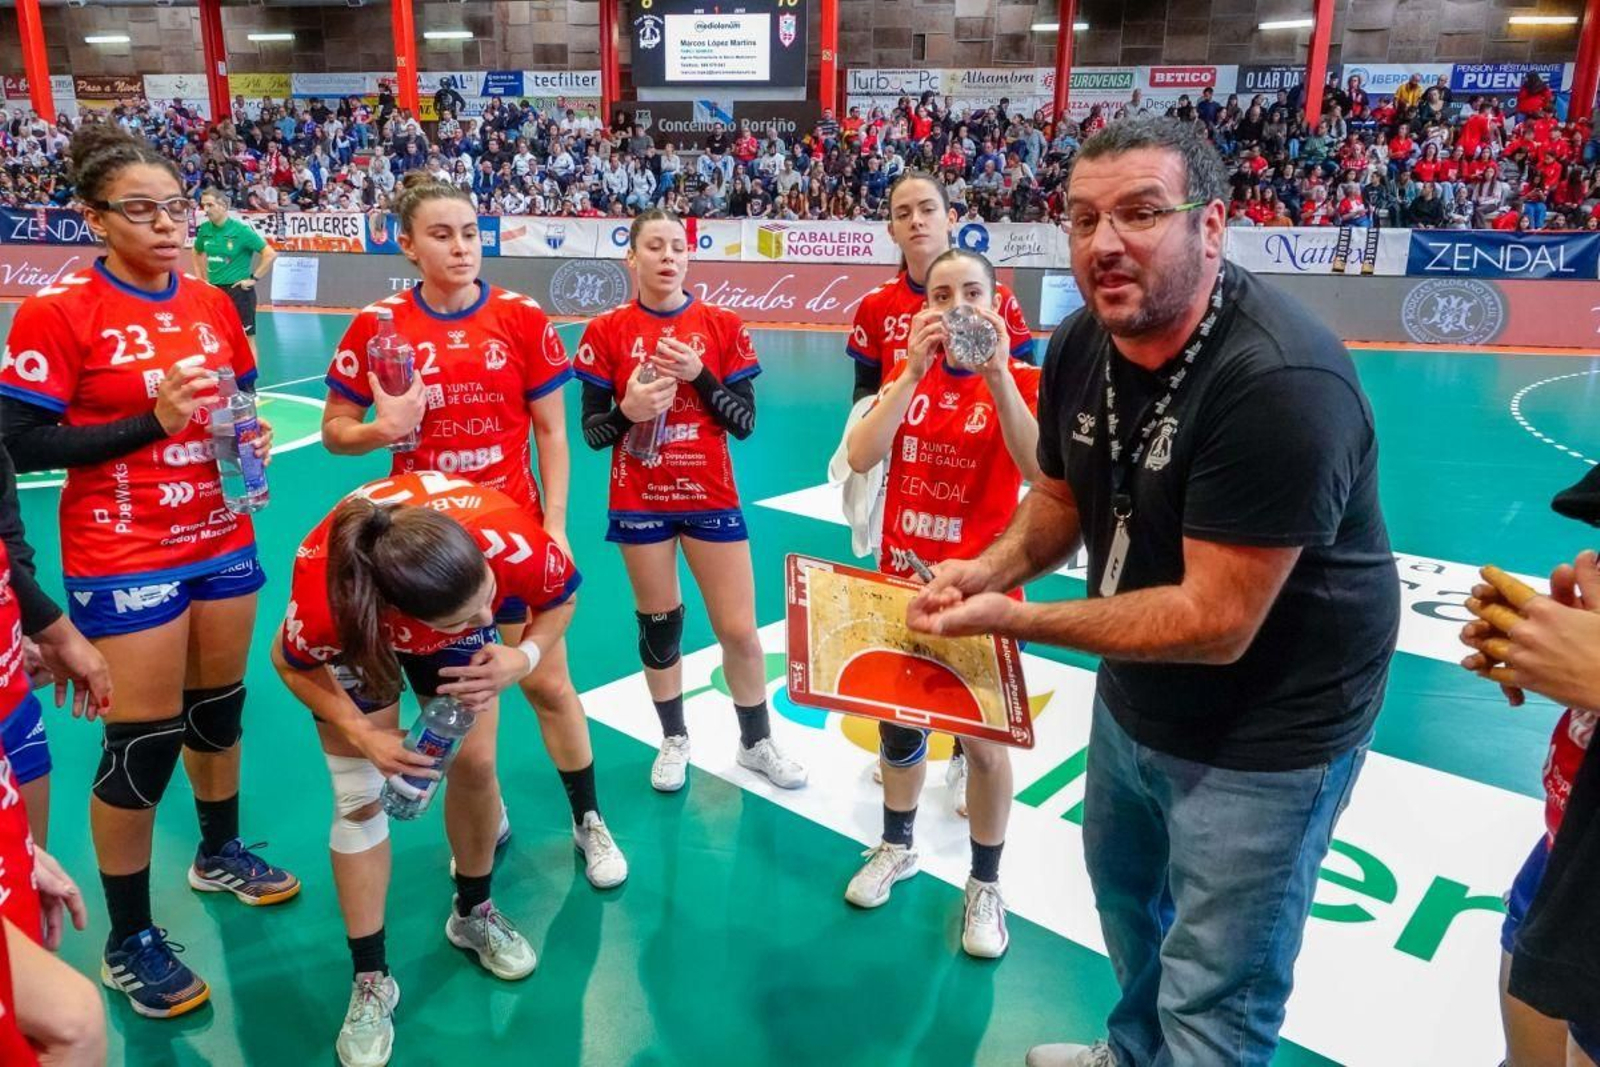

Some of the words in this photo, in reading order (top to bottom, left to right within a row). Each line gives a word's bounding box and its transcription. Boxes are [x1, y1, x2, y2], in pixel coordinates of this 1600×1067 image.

[535, 73, 597, 87] tecfilter
[850, 70, 902, 90] Turbo
[919, 70, 939, 90] Pc
[961, 70, 1034, 84] Alhambra
[1068, 73, 1132, 88] EUROVENSA
[1154, 72, 1213, 83] BETICO
[1257, 71, 1280, 89] LAR
[1283, 71, 1300, 88] DA
[1462, 72, 1551, 89] PUENE
[1146, 98, 1178, 109] Desca
[291, 216, 359, 237] TALLERES
[788, 231, 874, 244] CABALEIRO
[788, 244, 873, 257] NOGUEIRA
[1425, 242, 1575, 273] ZENDAL
[102, 324, 156, 367] 23
[446, 382, 484, 394] XUNTA
[447, 394, 461, 404] DE
[463, 393, 505, 403] GALICIA
[431, 417, 504, 437] ZENDAL
[921, 440, 957, 454] XUNTA
[437, 444, 505, 473] ORBE
[919, 452, 933, 464] DE
[935, 456, 977, 469] GALICIA
[647, 483, 675, 494] Grupo
[901, 474, 970, 504] ZENDAL
[113, 462, 132, 534] PipeWorks
[641, 492, 670, 503] Godoy
[901, 508, 963, 544] ORBE
